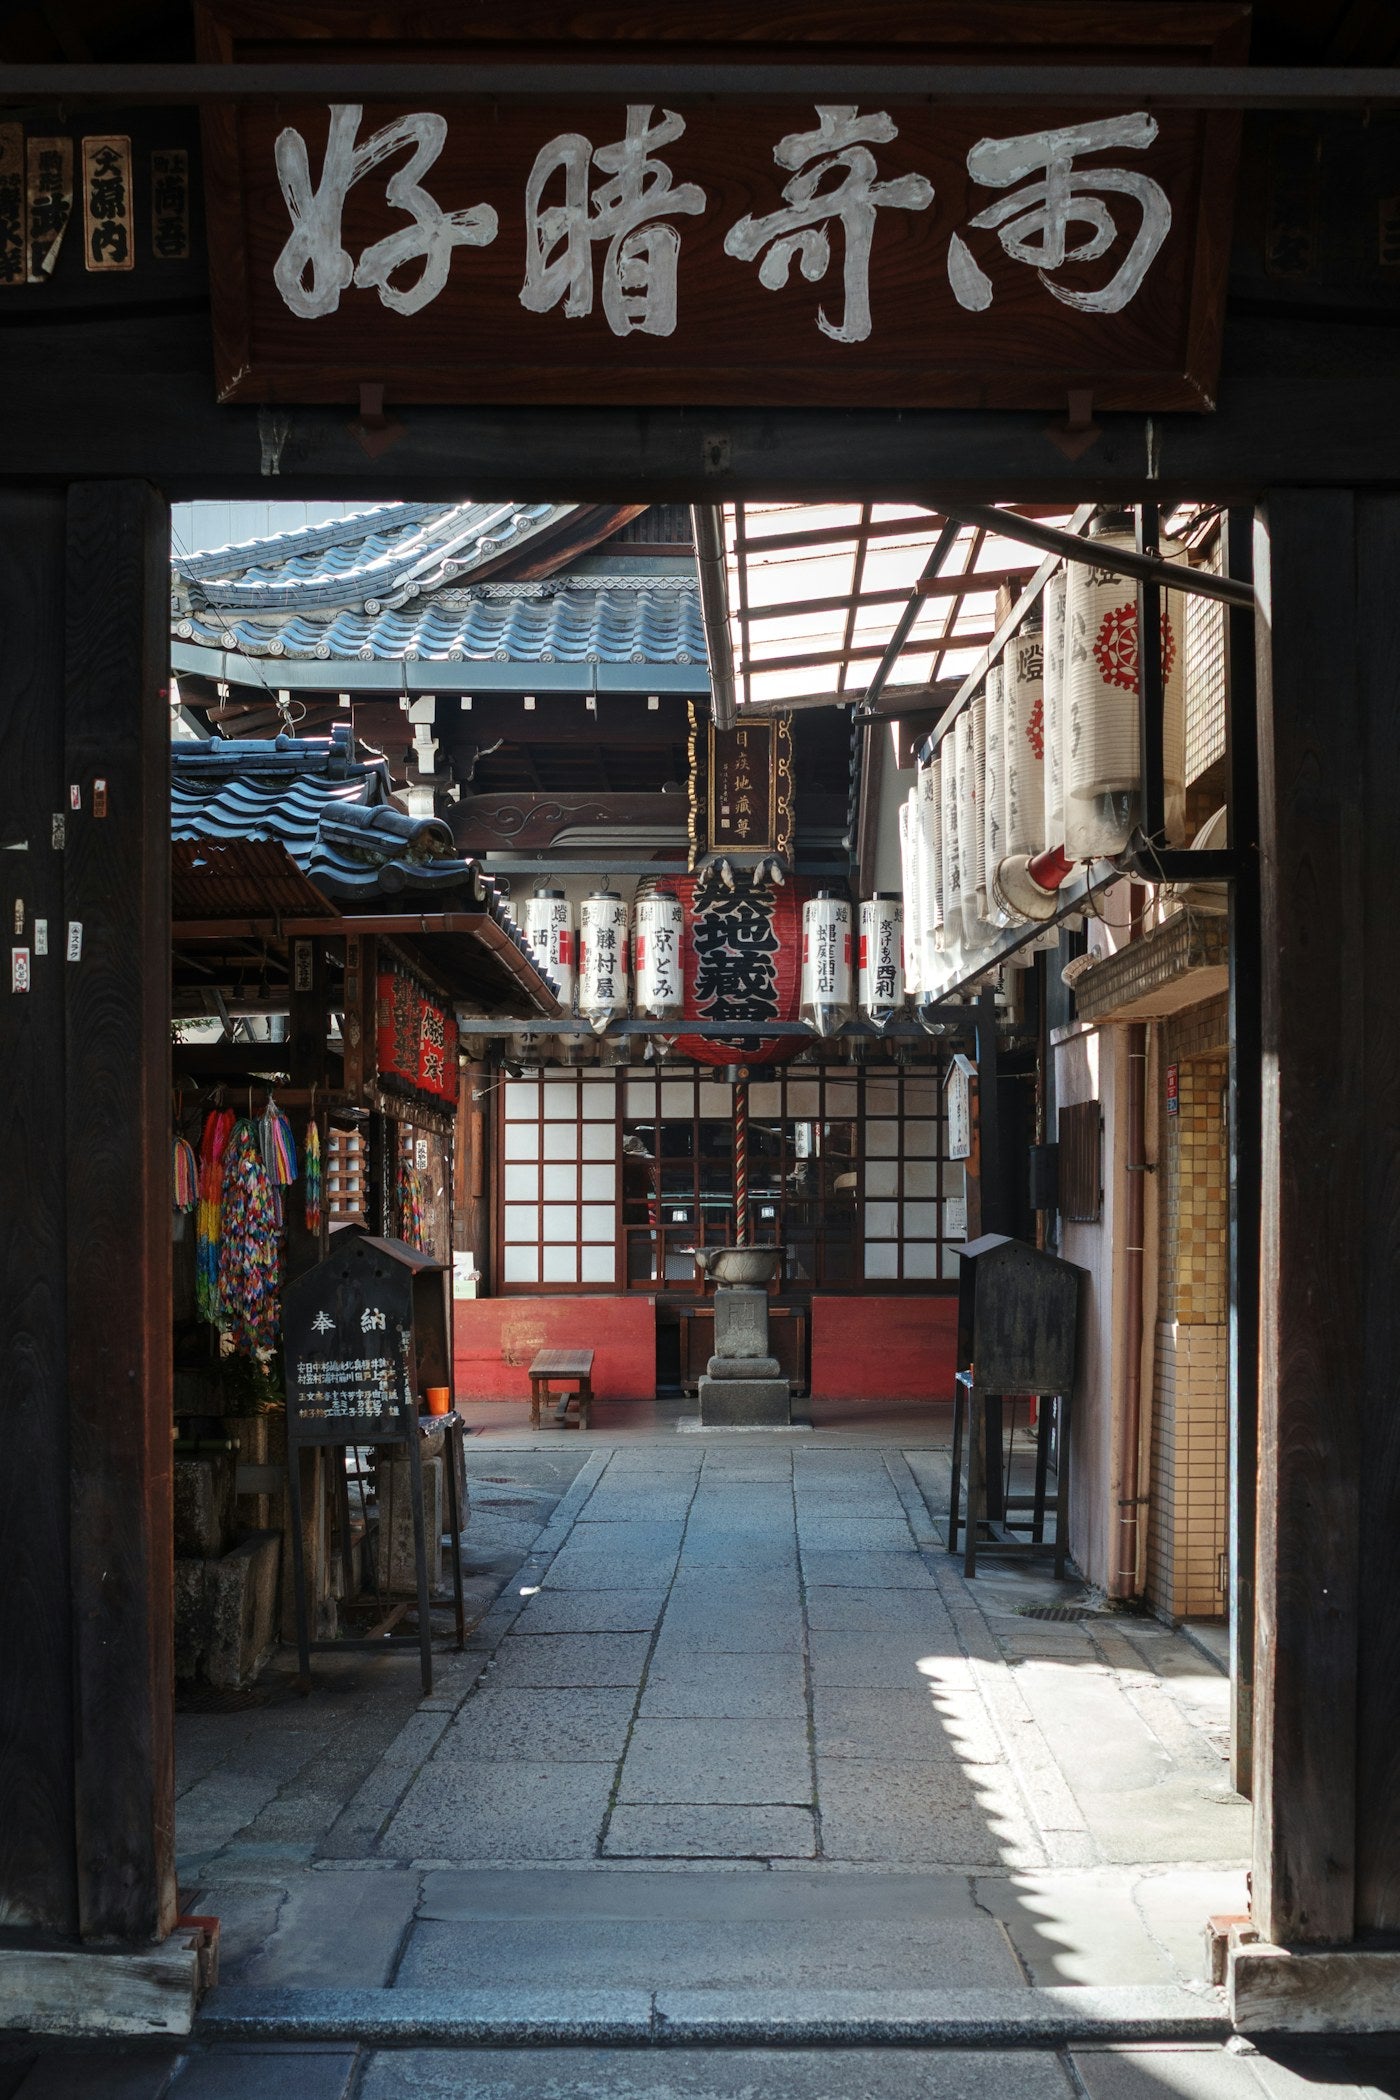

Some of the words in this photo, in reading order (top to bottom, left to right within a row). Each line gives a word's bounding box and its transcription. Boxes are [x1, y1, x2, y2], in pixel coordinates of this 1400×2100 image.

[595, 927, 618, 999] 藤村屋
[652, 927, 675, 998] 京とみ
[311, 1308, 387, 1336] 奉納
